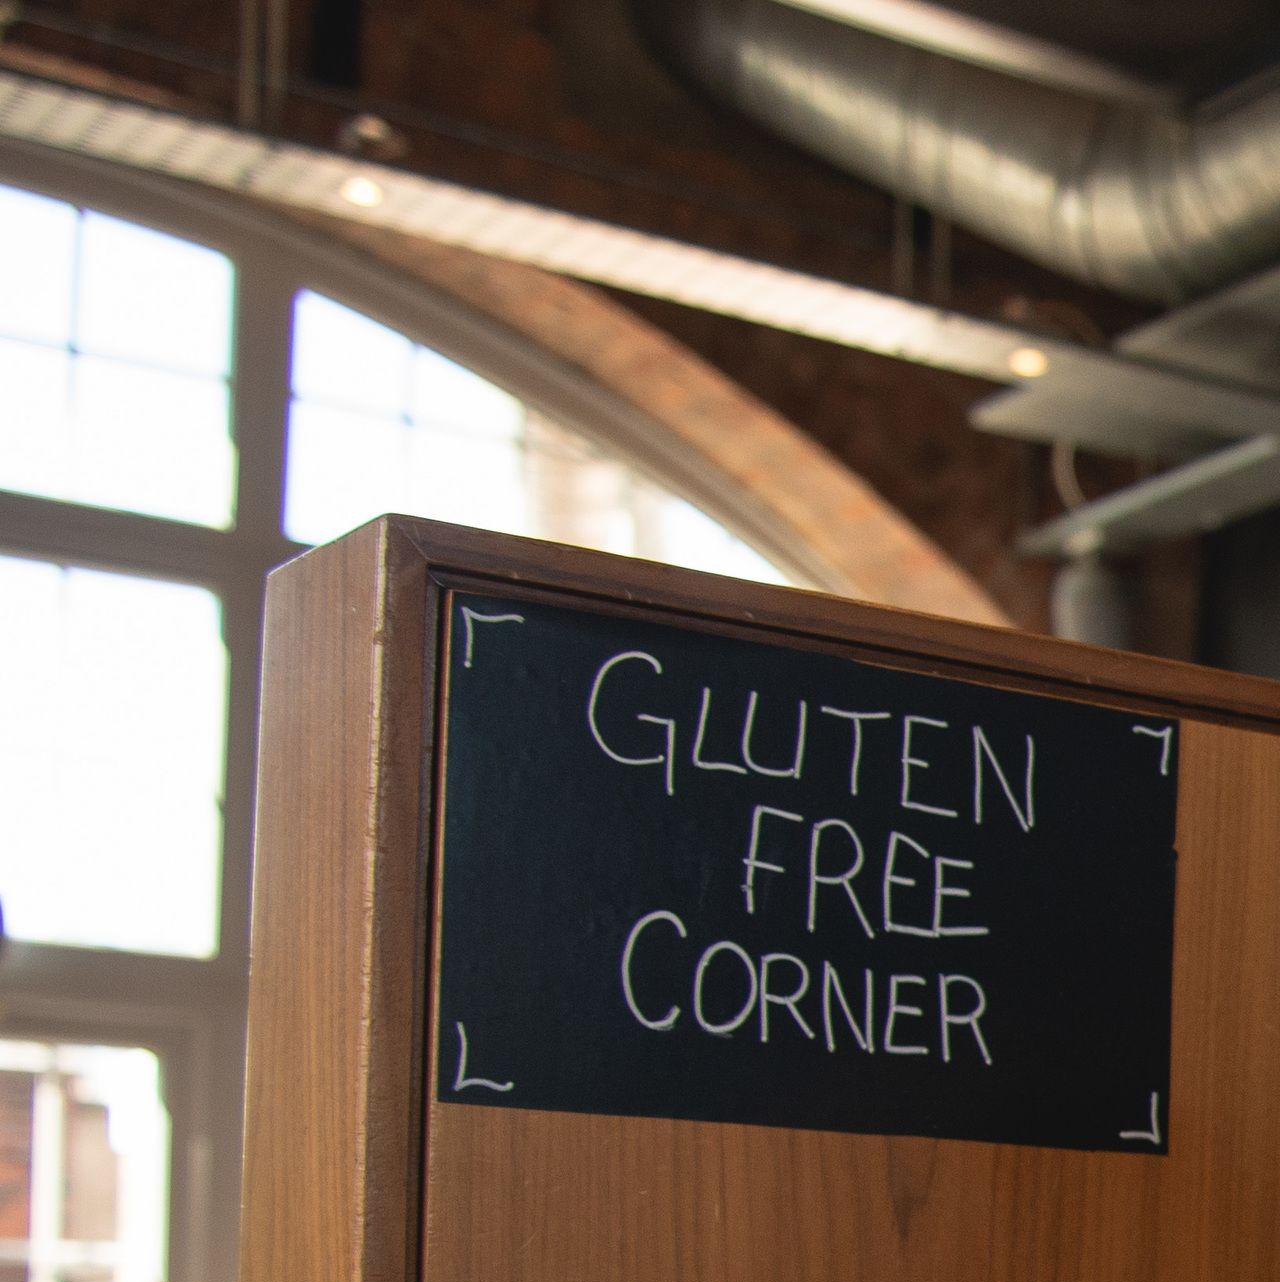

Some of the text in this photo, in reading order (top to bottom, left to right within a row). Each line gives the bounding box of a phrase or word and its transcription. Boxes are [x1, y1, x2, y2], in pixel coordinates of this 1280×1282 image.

[587, 651, 1034, 831] GLUTEN
[742, 805, 989, 938] FREE
[621, 910, 992, 1065] CORNER
